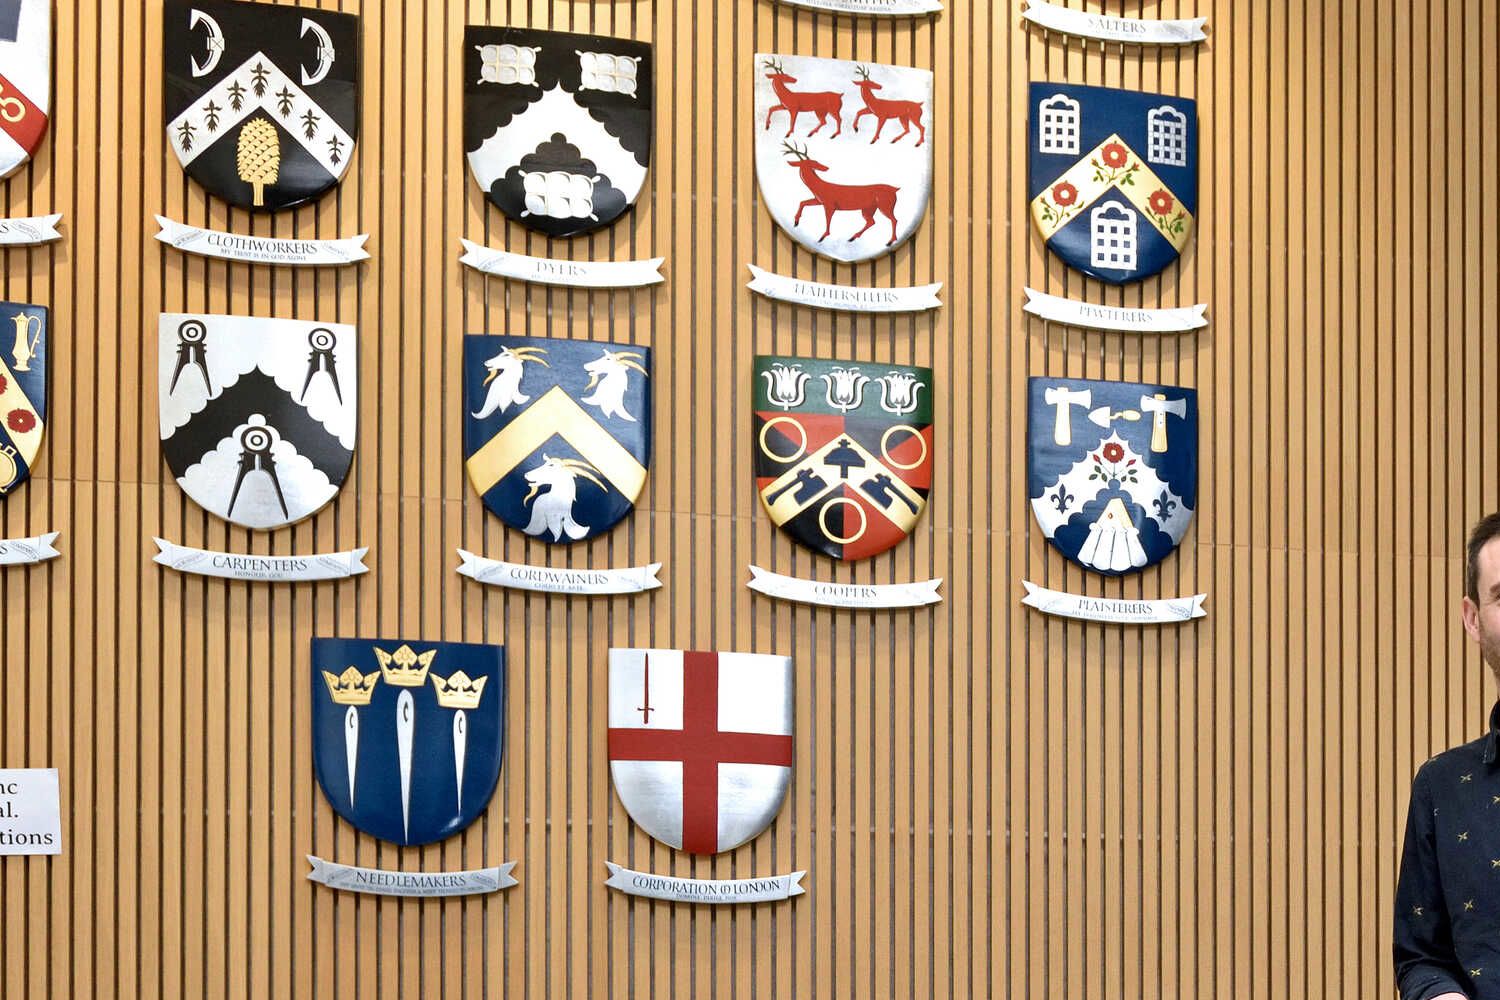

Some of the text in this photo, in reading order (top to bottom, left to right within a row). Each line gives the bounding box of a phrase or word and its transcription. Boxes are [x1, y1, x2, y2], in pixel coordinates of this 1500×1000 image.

[1088, 18, 1146, 34] SALTERS
[207, 233, 318, 255] CLOTHWORKERS
[537, 261, 588, 276] DYERS
[212, 555, 308, 572] CARPENTERS
[510, 568, 609, 585] CORDWAINERS
[814, 585, 877, 598] COOPERS
[1078, 599, 1153, 615] PLAISTERERS
[356, 871, 466, 888] NEEDLEMAKERS
[632, 875, 717, 895] CORPORATION
[734, 879, 780, 894] LONDON
